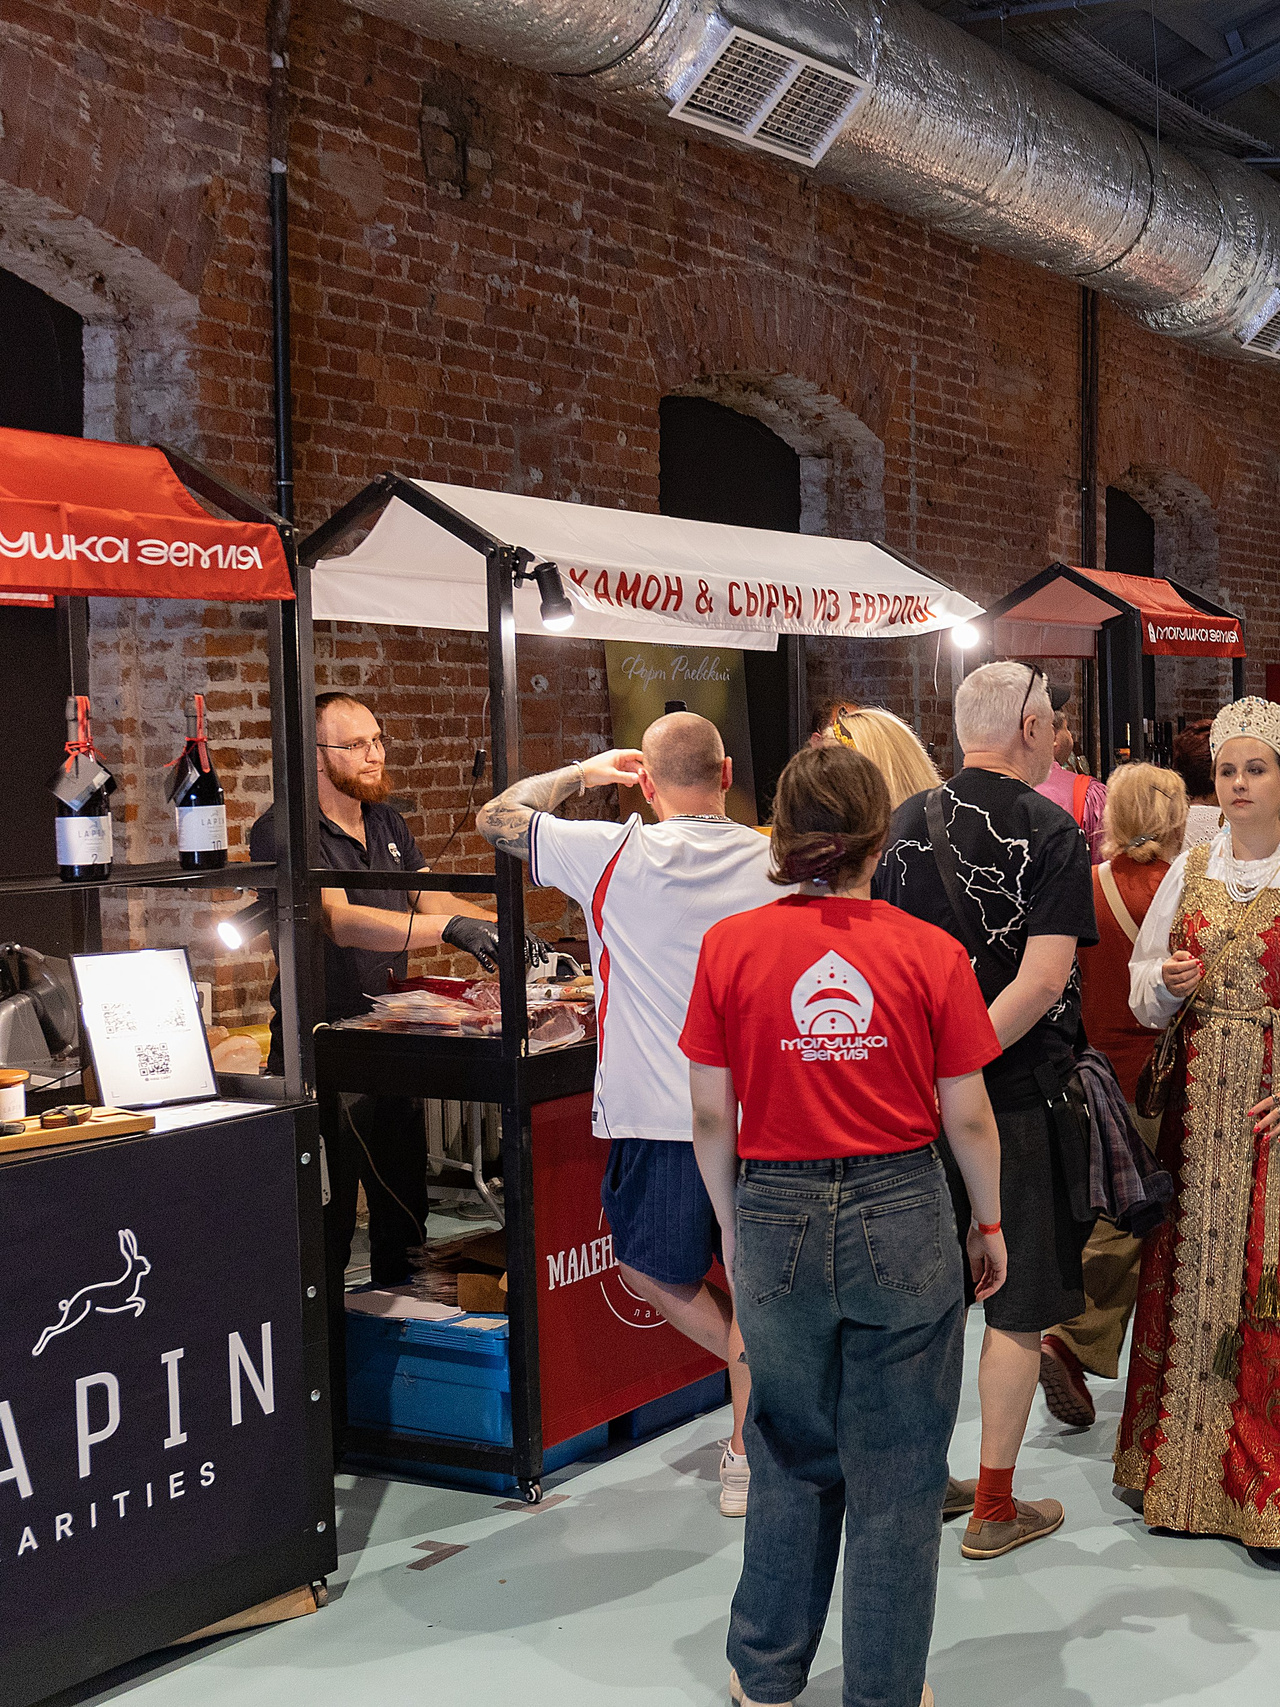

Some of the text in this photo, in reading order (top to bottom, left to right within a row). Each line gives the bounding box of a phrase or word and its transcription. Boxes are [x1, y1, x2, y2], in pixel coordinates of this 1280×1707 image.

[569, 567, 938, 625] ХАМОН & СЫРЫ ИЗ ЕВРОПЫ
[621, 653, 731, 692] Форт Раевский
[546, 1233, 620, 1291] МАЛЕН
